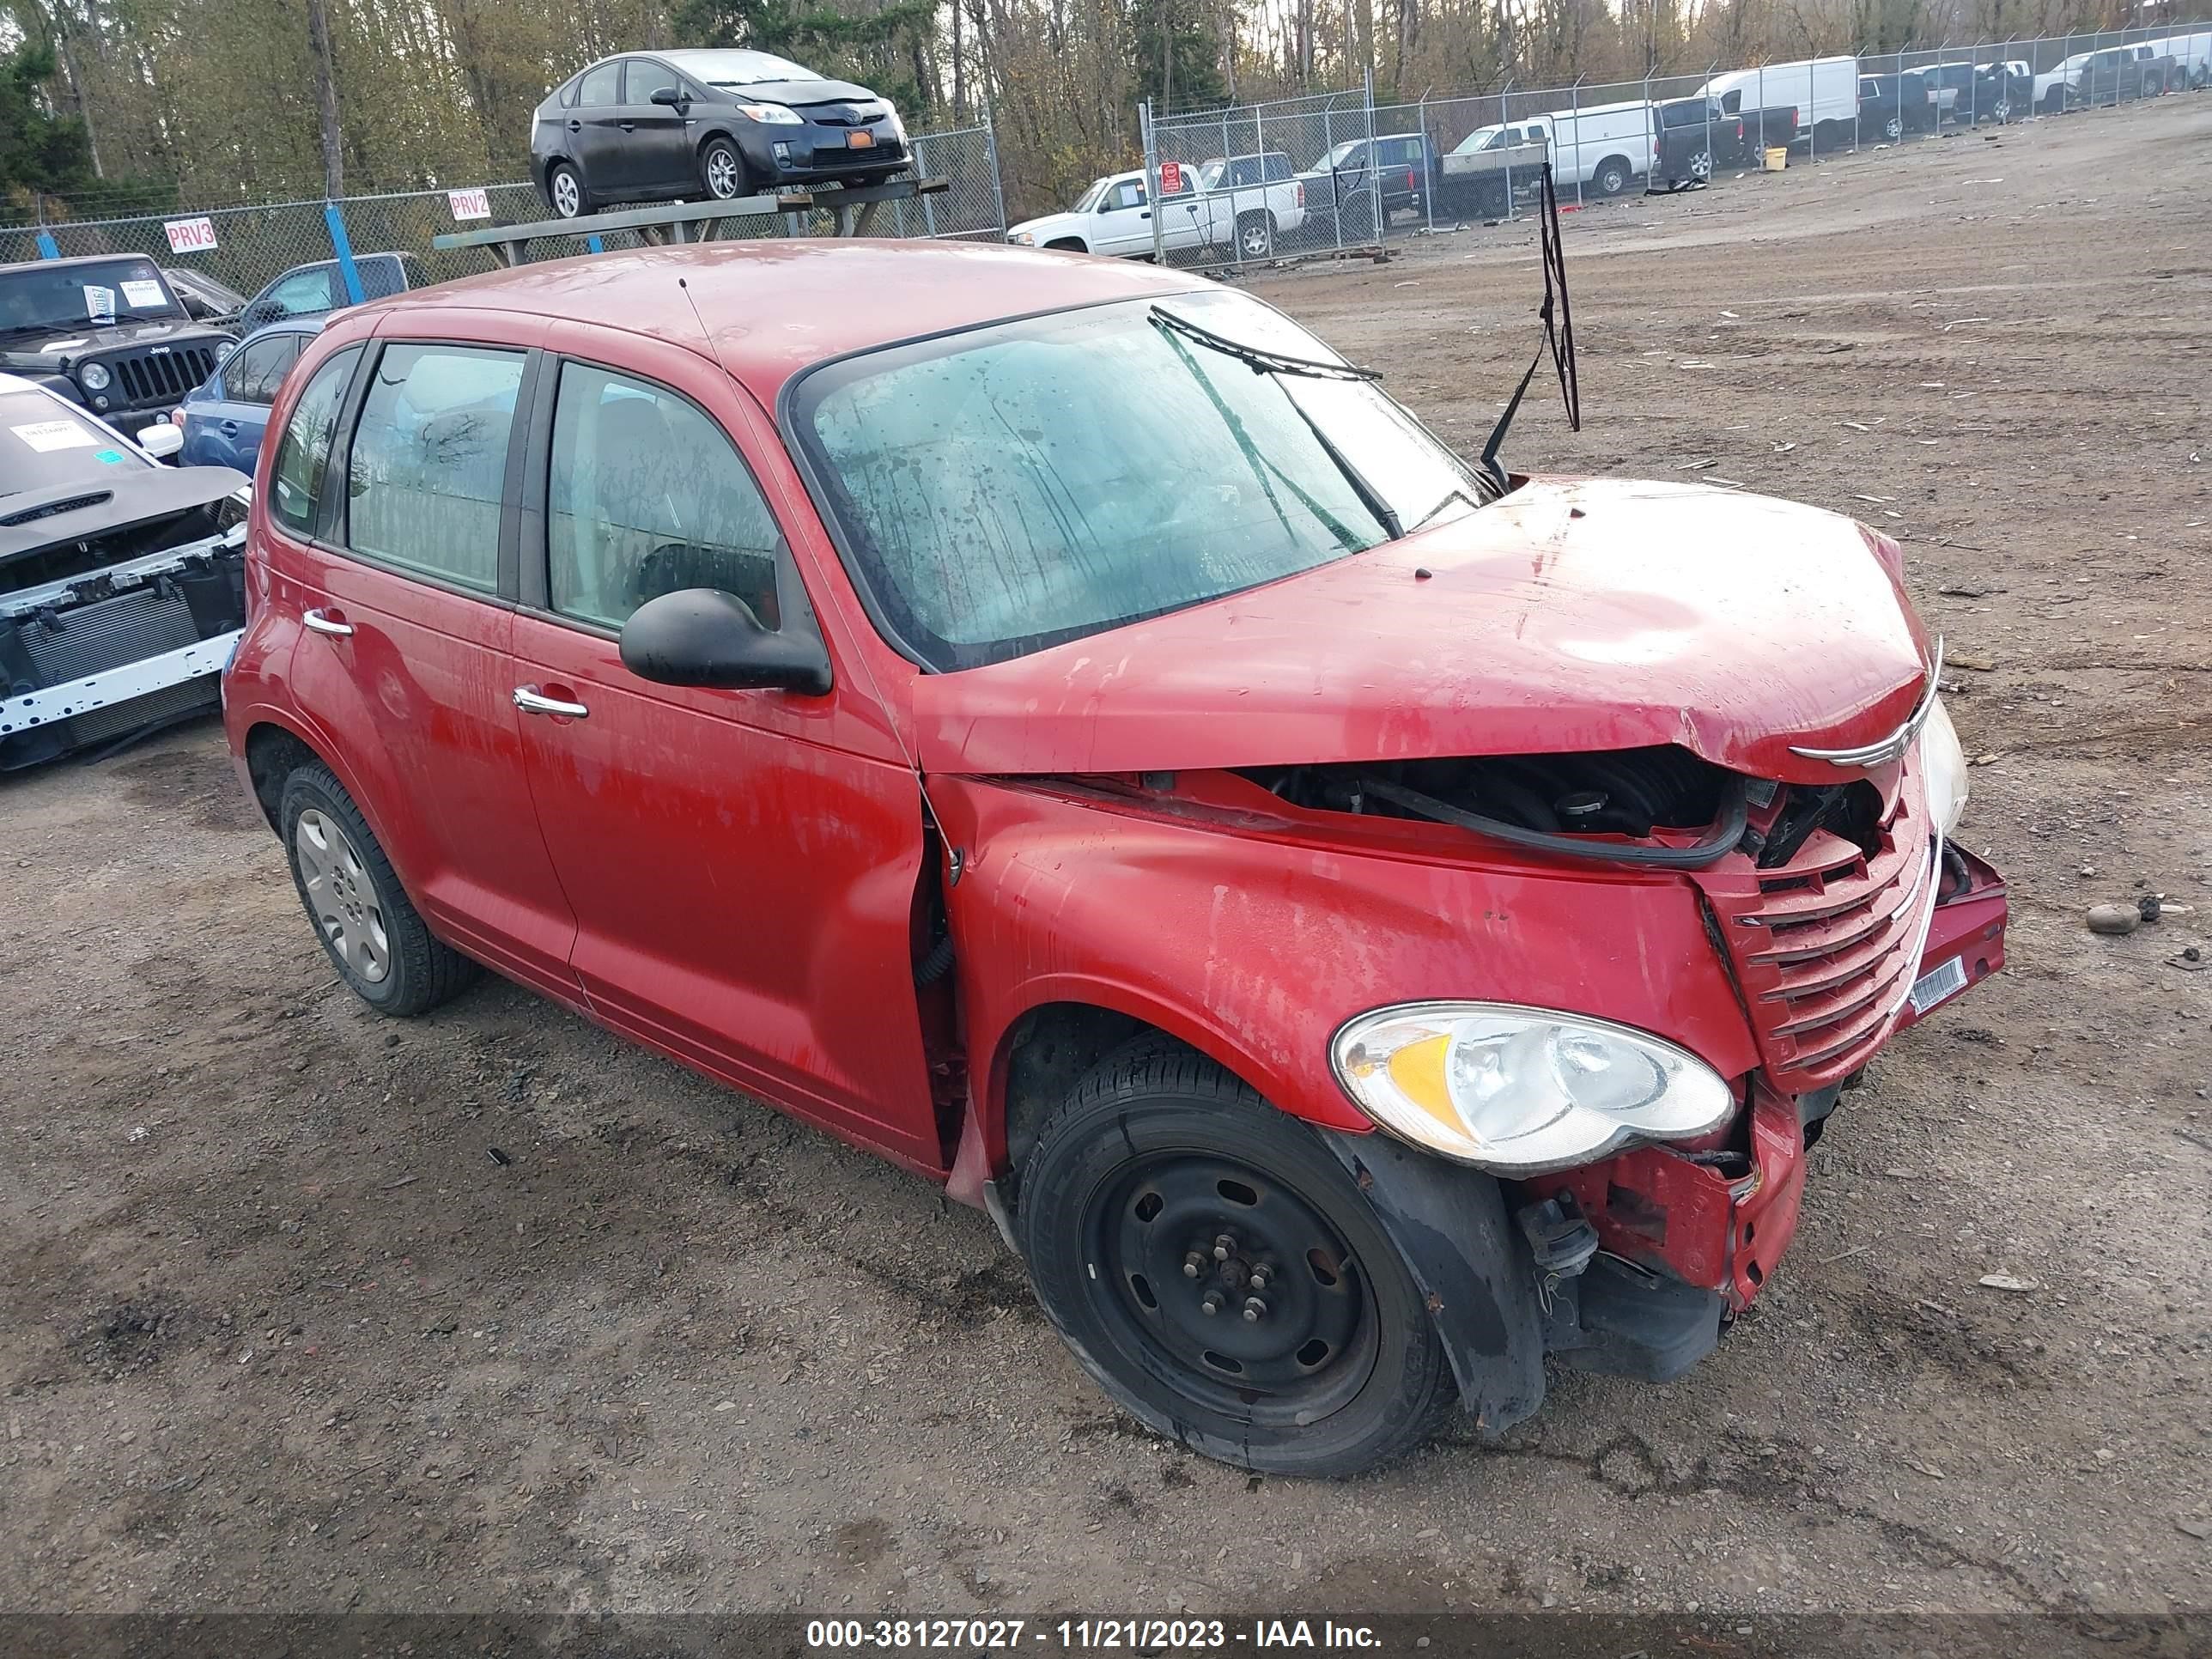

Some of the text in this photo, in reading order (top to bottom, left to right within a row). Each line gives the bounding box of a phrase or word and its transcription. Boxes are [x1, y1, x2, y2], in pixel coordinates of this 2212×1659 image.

[451, 194, 489, 215] PRV2
[167, 223, 214, 248] PRV3
[149, 346, 170, 355] Jeep
